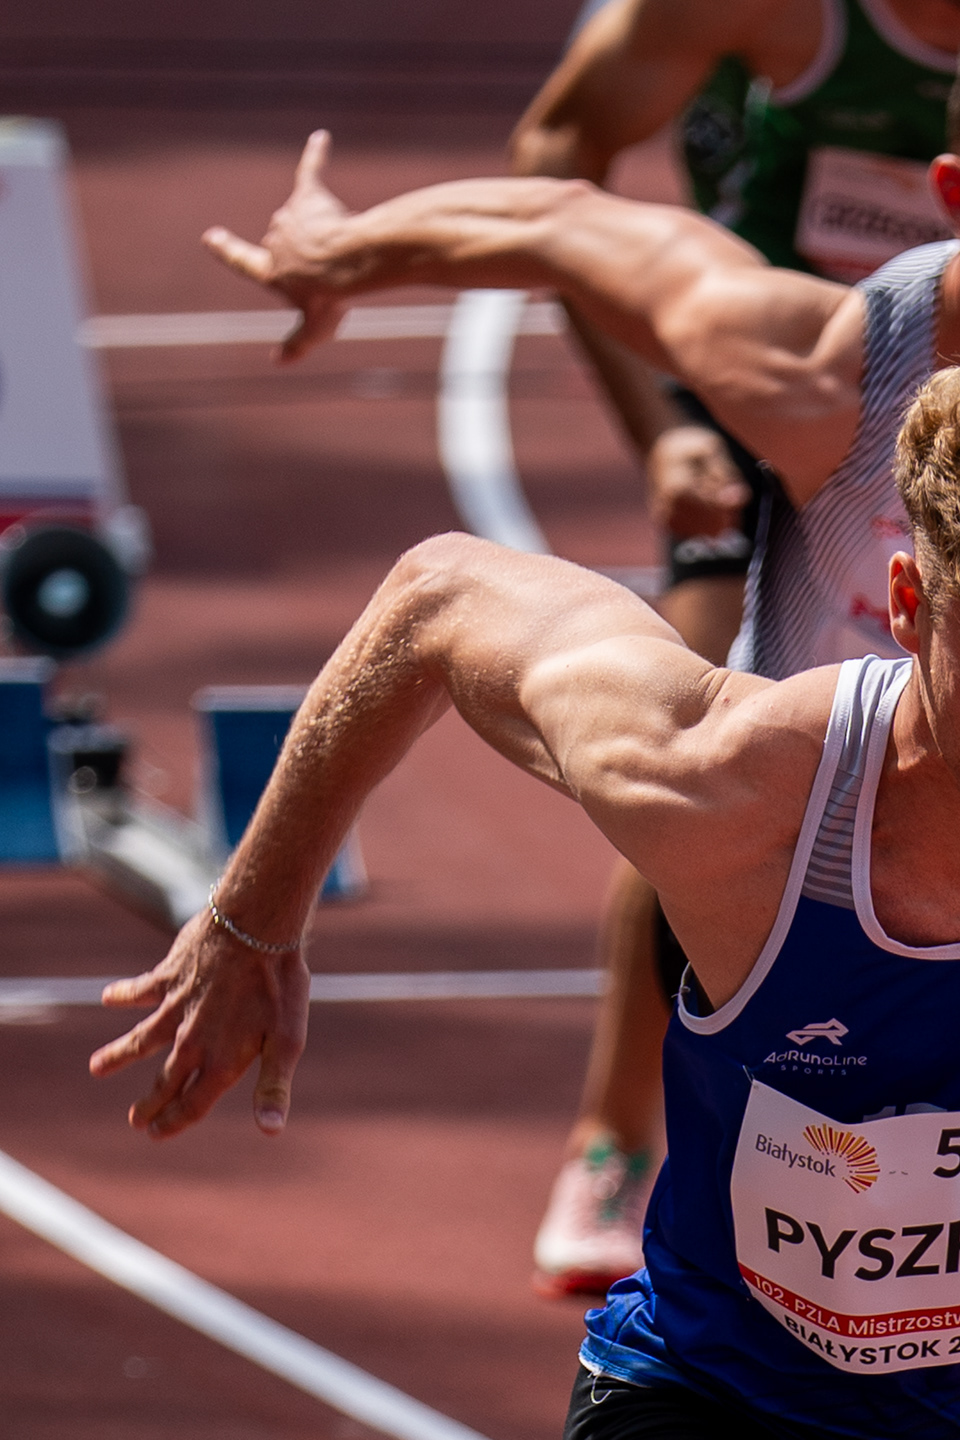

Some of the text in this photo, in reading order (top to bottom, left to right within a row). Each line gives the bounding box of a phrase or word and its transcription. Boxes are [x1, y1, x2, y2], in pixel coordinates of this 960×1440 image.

[780, 1064, 847, 1076] SPORTS
[755, 1133, 836, 1178] Białystok
[754, 1275, 789, 1307] 102.
[794, 1298, 841, 1332] PZLA
[784, 1314, 941, 1365] BIAŁYSTOK
